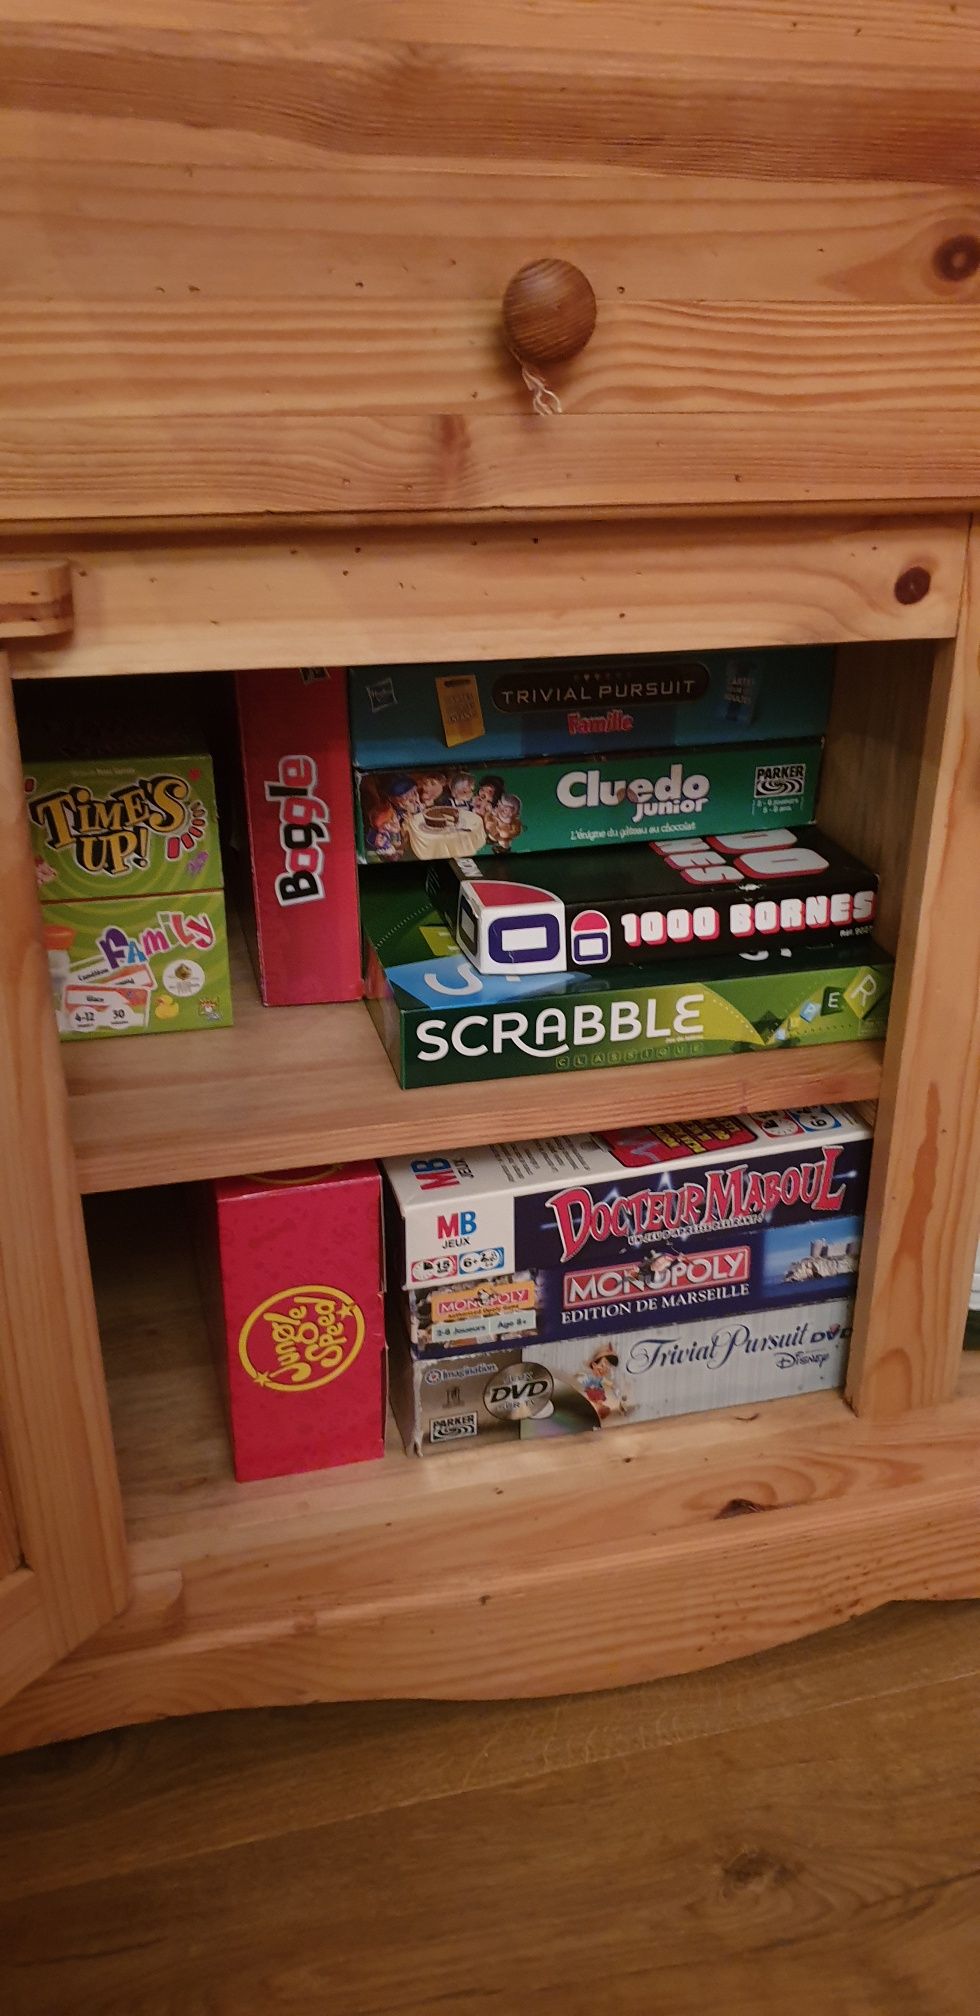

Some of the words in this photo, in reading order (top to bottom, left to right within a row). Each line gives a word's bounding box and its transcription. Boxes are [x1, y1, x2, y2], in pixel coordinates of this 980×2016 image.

[502, 687, 592, 705] TRIVIAL
[598, 680, 696, 699] PURSUIT
[567, 710, 633, 735] Famille
[556, 764, 710, 808] Cluedo
[757, 766, 804, 780] PARKER
[631, 797, 709, 823] junior
[264, 755, 330, 906] Boggle
[76, 828, 149, 876] UP!
[621, 906, 719, 946] 1000
[730, 890, 874, 937] BORNES
[416, 994, 704, 1062] SCRABBLE
[545, 1184, 705, 1262] DOCTEUR
[705, 1146, 846, 1221] MABOUL
[437, 1211, 477, 1240] MB
[442, 1236, 471, 1249] JEUX
[436, 1260, 450, 1270] 15
[568, 1252, 744, 1303] MONOPOLY
[562, 1302, 631, 1325] EDITION
[636, 1299, 657, 1311] DE
[661, 1284, 750, 1309] MARSEILLE
[263, 1305, 319, 1382] Jungle
[294, 1296, 347, 1368] Speed
[626, 1334, 716, 1374] Trivial
[706, 1323, 808, 1369] Pursuit
[774, 1352, 829, 1371] Disney
[491, 1380, 548, 1404] DVD
[433, 1414, 475, 1428] PARKER
